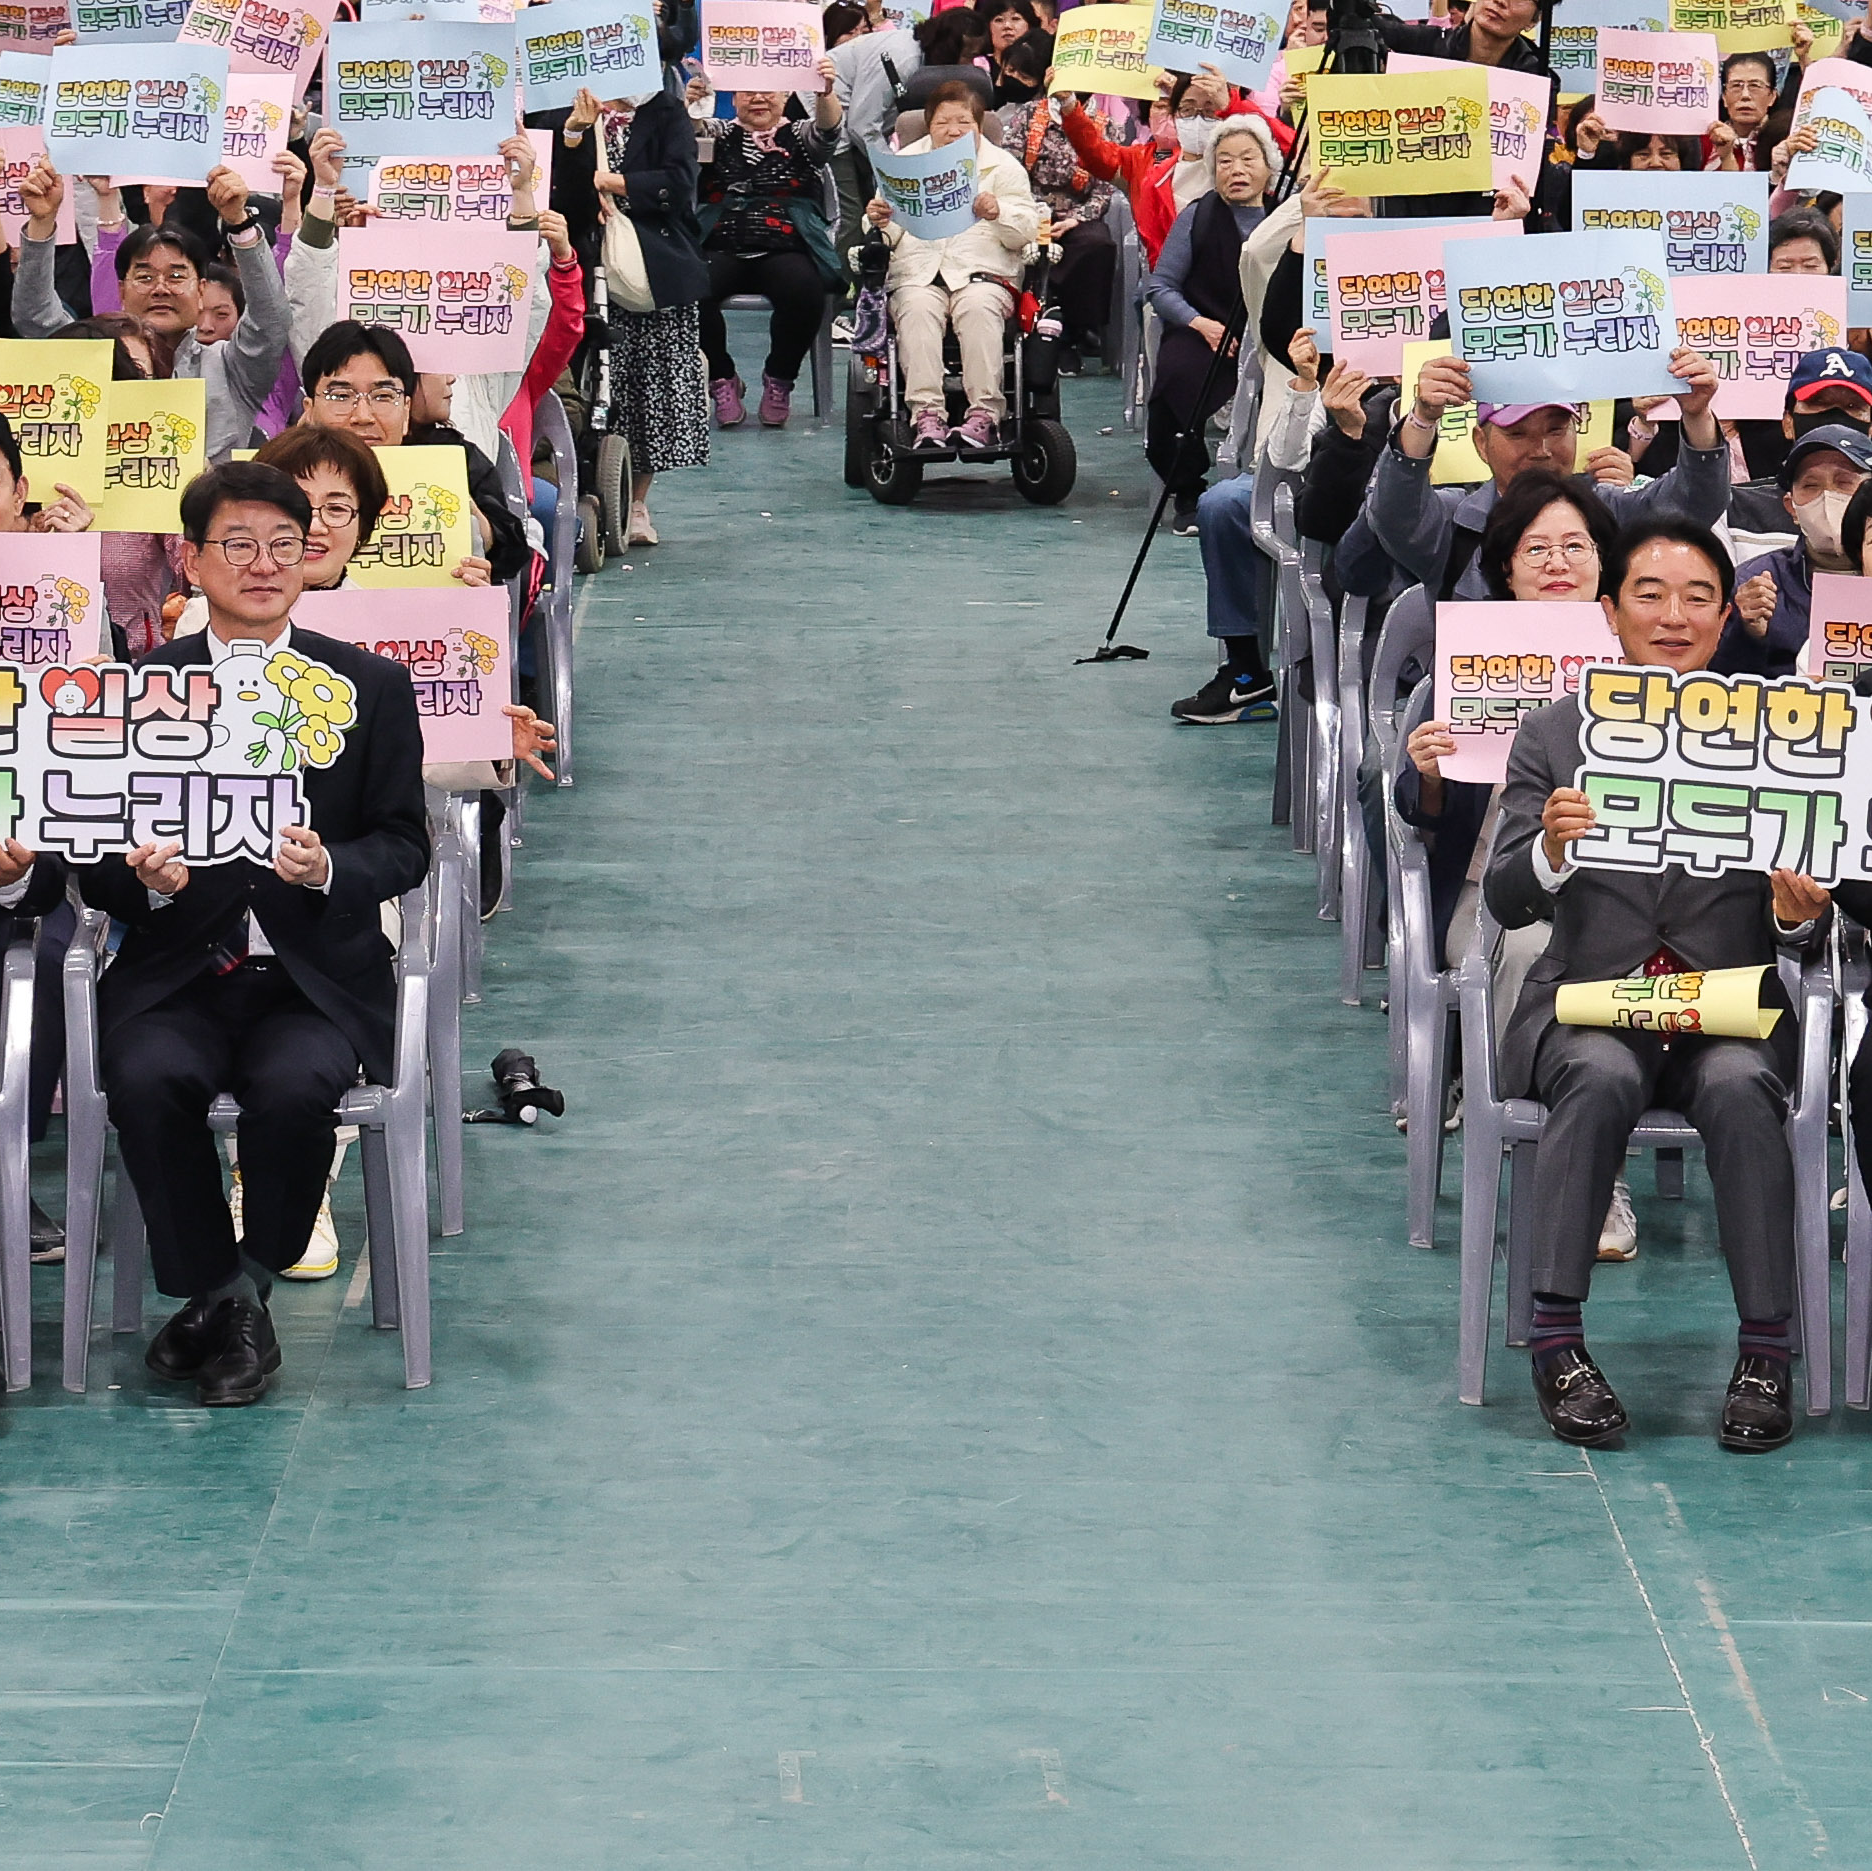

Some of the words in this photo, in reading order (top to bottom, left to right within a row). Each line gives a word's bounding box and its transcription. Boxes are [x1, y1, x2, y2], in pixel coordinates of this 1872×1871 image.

[527, 31, 584, 58] 당연한
[585, 26, 623, 48] 일상
[337, 61, 412, 90] 당연한
[418, 59, 469, 89] 일상
[530, 57, 587, 85] 모두가
[589, 46, 643, 76] 누리자
[1603, 58, 1654, 81] 당연한
[1659, 63, 1694, 84] 일상
[57, 80, 130, 107] 당연한
[135, 78, 187, 110] 일상
[338, 92, 413, 122] 모두가
[419, 91, 493, 120] 누리자
[1603, 82, 1653, 105] 모두가
[1657, 86, 1709, 108] 누리자
[52, 108, 127, 138] 모두가
[133, 111, 209, 143] 누리자
[1318, 109, 1392, 137] 당연한
[1396, 106, 1446, 133] 일상
[1319, 138, 1392, 166] 모두가
[1397, 133, 1469, 161] 누리자
[1460, 286, 1556, 322] 당연한
[1559, 279, 1623, 315] 일상
[1462, 324, 1556, 362] 모두가
[1563, 316, 1659, 354] 누리자
[1819, 352, 1855, 378] A
[40, 666, 220, 760] 일상
[1586, 668, 1855, 776] 당연한
[44, 770, 305, 866] 누리자
[1572, 771, 1847, 885] 모두가
